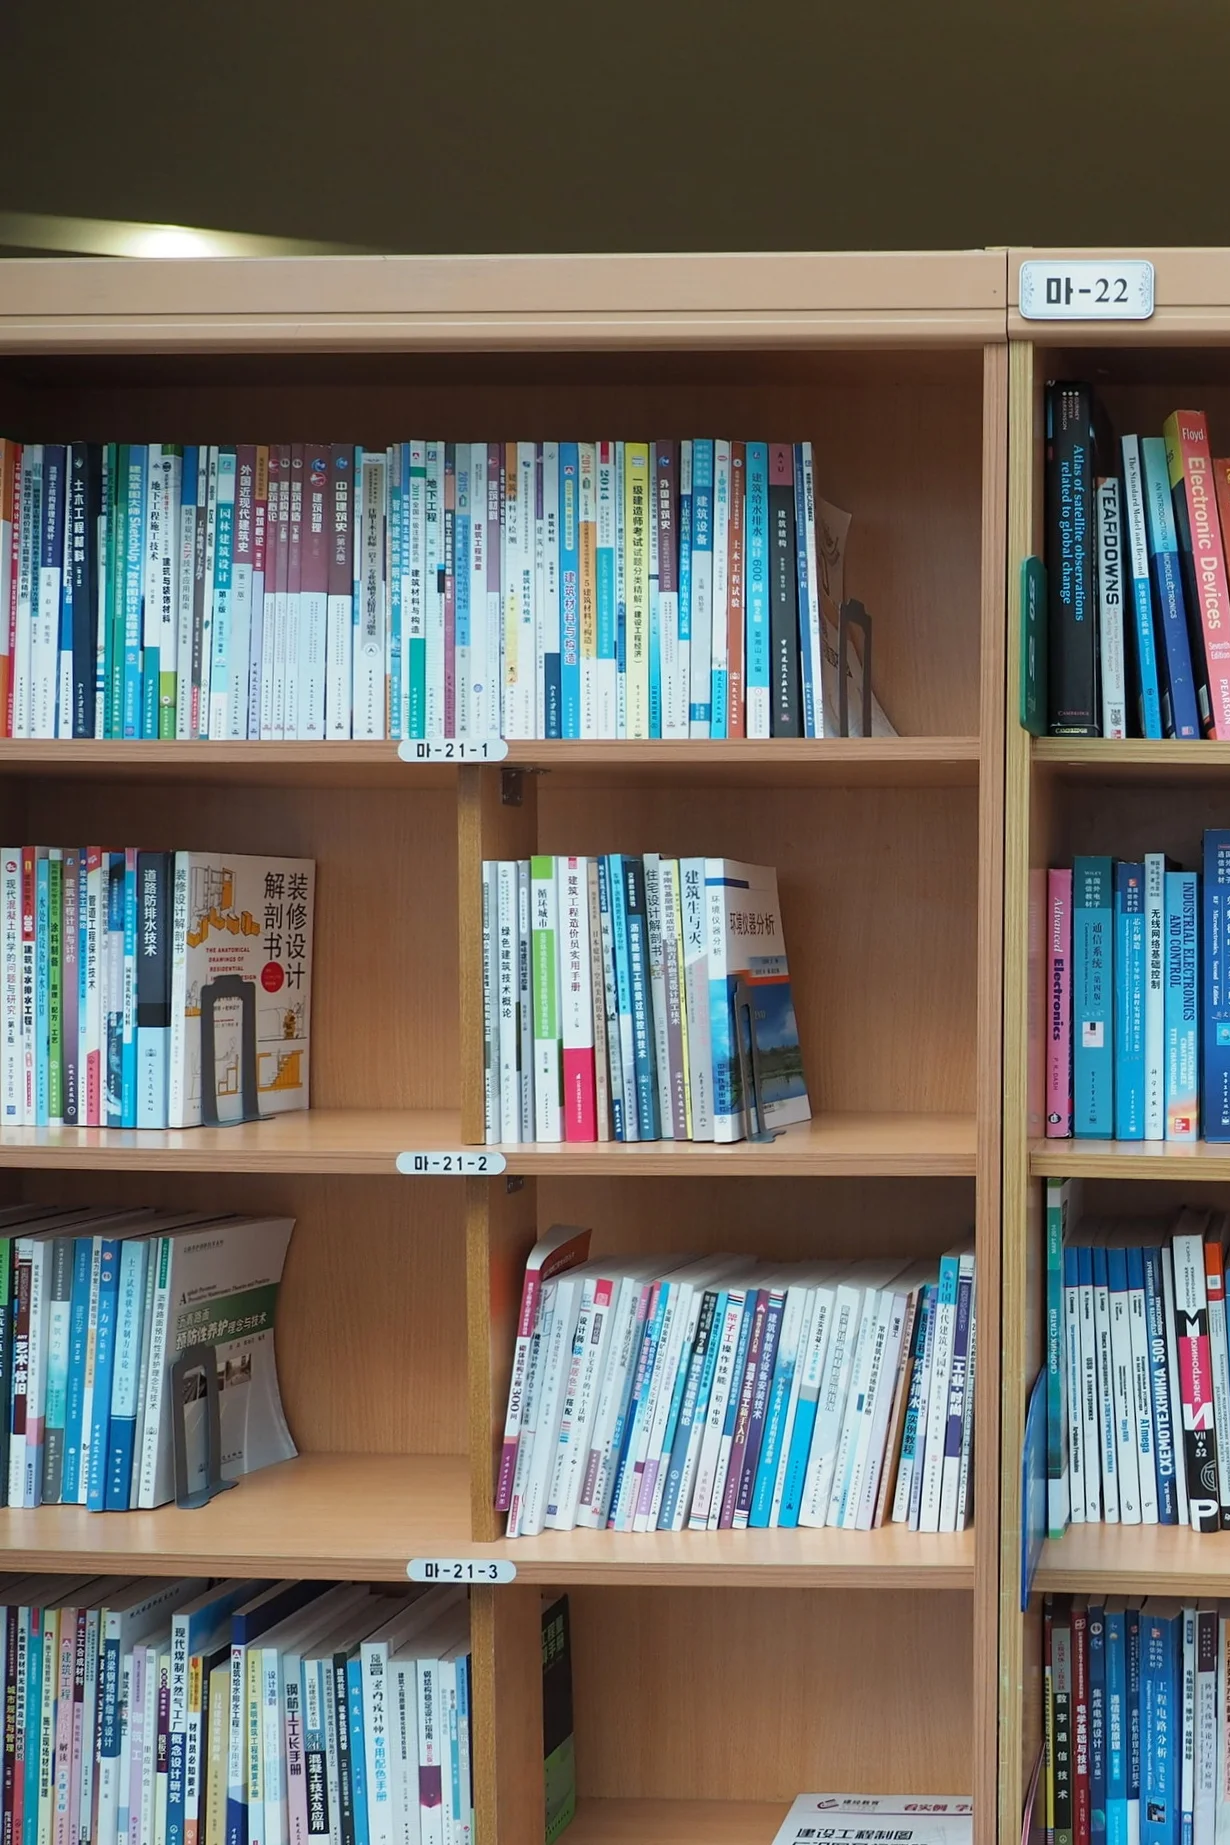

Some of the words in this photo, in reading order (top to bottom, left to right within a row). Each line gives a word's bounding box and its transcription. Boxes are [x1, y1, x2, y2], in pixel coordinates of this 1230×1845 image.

[1045, 276, 1129, 306] 마-22
[1073, 444, 1084, 476] Atlas
[1182, 428, 1204, 443] Floyd
[236, 464, 252, 554] 外国近现代建筑史
[311, 492, 323, 534] 建筑物理
[426, 478, 437, 523] 地下工程
[600, 469, 610, 501] 2014
[1061, 461, 1073, 503] related
[1188, 457, 1214, 550] Electronic
[73, 479, 85, 563] 土木工程材料
[127, 516, 142, 562] SketchUp
[148, 480, 162, 562] 地下工程施工技术
[217, 508, 230, 583] 园林建筑设计
[696, 494, 710, 546] 建筑设备
[777, 509, 788, 548] 建筑结构
[1059, 520, 1073, 559] global
[1074, 494, 1086, 546] satellite
[1101, 483, 1121, 606] TEARDOWNS
[161, 557, 172, 624] 建筑与装饰材料
[410, 568, 421, 635] 建筑材料与构造
[730, 539, 741, 609] 土木工程试验
[1060, 563, 1073, 604] change
[1074, 548, 1085, 621] observations
[1163, 552, 1177, 620] MICROELECTRONICS
[1200, 556, 1222, 630] Devices
[563, 570, 577, 665] 建筑材料与构造
[1210, 652, 1230, 660] Edition
[416, 743, 487, 758] 마-21-1
[64, 877, 77, 964] 建筑工程计量与计价
[143, 868, 158, 957] 道路防排水技术
[174, 868, 188, 954] 装修设计解剖书
[262, 871, 287, 961] 解剖书
[284, 872, 309, 991] 装修设计
[537, 888, 549, 929] 循环城市
[567, 874, 582, 993] 建筑工程造价员实用手册
[645, 868, 663, 957] 住宅设计解剖书
[684, 869, 702, 946] 建筑生与灭
[710, 894, 722, 958] 环境仪器分析
[729, 910, 776, 937] 环境仪器分析
[1053, 897, 1065, 953] Advanced
[1170, 914, 1182, 935] AND
[1182, 881, 1195, 945] INDUSTRIAL
[500, 925, 512, 1018] 绿色建筑技术概论
[1091, 922, 1103, 969] 通信系统
[1150, 908, 1161, 990] 无线网络基础控制
[1169, 937, 1182, 988] CONTROL
[23, 944, 34, 1026] 建筑给水排水工程
[1053, 958, 1065, 1042] Electronics
[1182, 947, 1195, 1021] ELECTRONICS
[414, 1155, 487, 1171] 마-21-2
[120, 1256, 137, 1370] 土工试验状态控制方法论
[564, 1315, 589, 1417] 设计师谈家居色彩搭配
[752, 1312, 777, 1420] 建筑智能化设备安装技术
[1152, 1338, 1165, 1363] 500
[1191, 1337, 1202, 1403] электроники
[1140, 1418, 1150, 1454] ATmega
[1153, 1368, 1174, 1476] СХЕМОТЕХНИКА
[1195, 1448, 1207, 1458] 52
[425, 1563, 497, 1579] 마-21-3
[74, 1627, 86, 1687] 土工合成材料
[103, 1649, 117, 1748] 桥梁钢结构细节设计
[286, 1682, 302, 1776] 钢筋工工长手册
[40, 1716, 51, 1799] 施工现场材料管理
[186, 1722, 199, 1799] 材料员必知要点
[1056, 1693, 1069, 1800] 数字通信技术
[1076, 1703, 1088, 1776] 电学基础与技能
